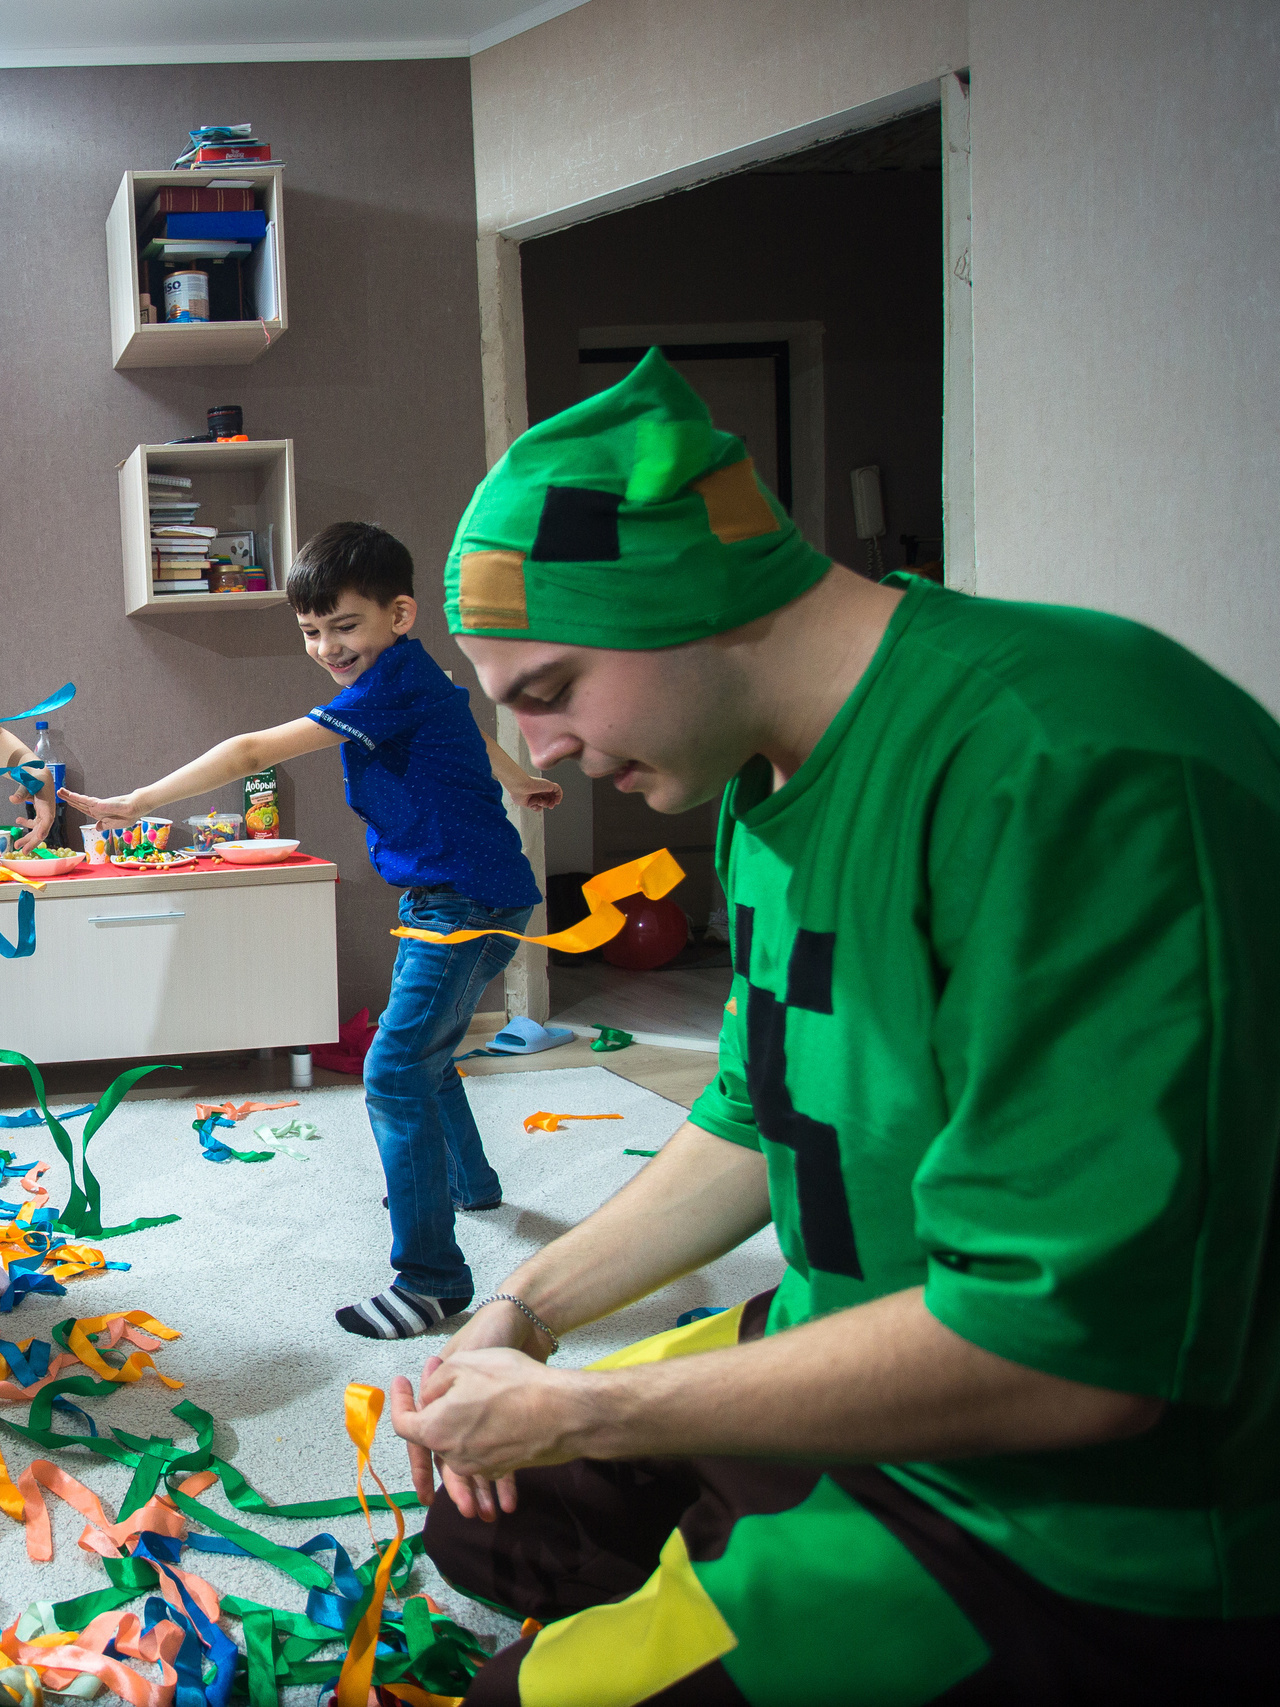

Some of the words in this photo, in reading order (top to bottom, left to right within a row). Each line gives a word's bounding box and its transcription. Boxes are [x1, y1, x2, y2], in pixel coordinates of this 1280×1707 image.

[331, 718, 352, 733] FASHION
[351, 728, 364, 739] NEW
[245, 779, 277, 793] Добрый
